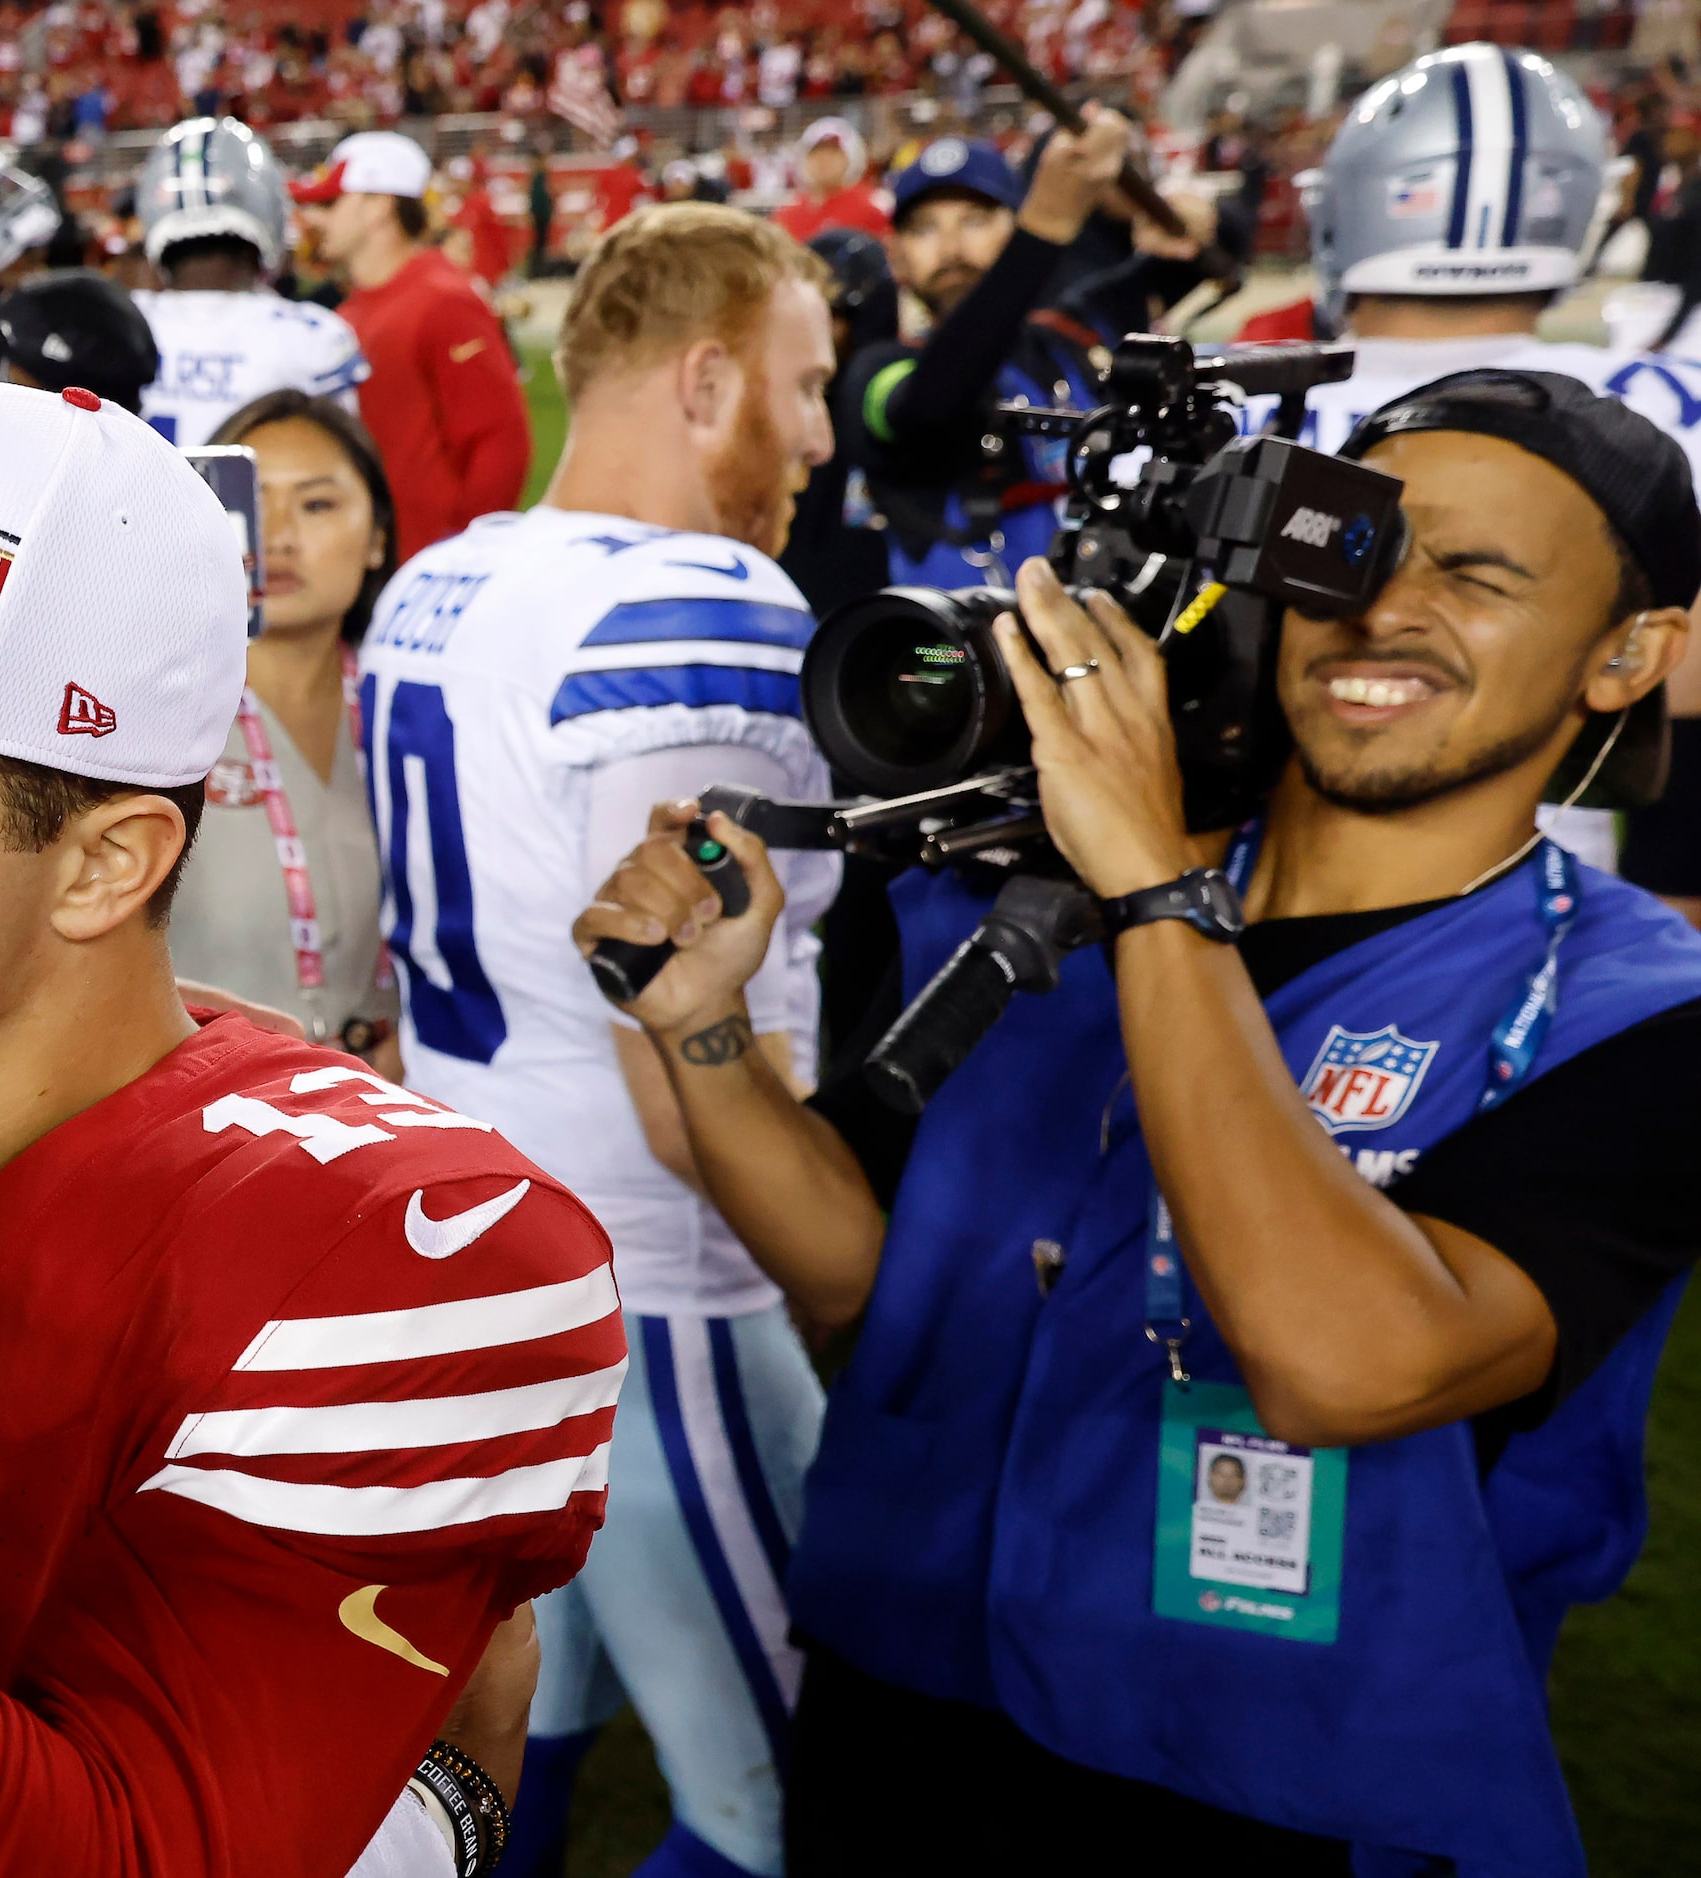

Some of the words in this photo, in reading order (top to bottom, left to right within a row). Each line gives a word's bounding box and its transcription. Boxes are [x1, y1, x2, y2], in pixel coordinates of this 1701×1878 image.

[201, 1066, 495, 1165] 13
[1309, 1068, 1392, 1117] NFL
[417, 1759, 468, 1816] COFFEE
[459, 1812, 479, 1860] BEAN
